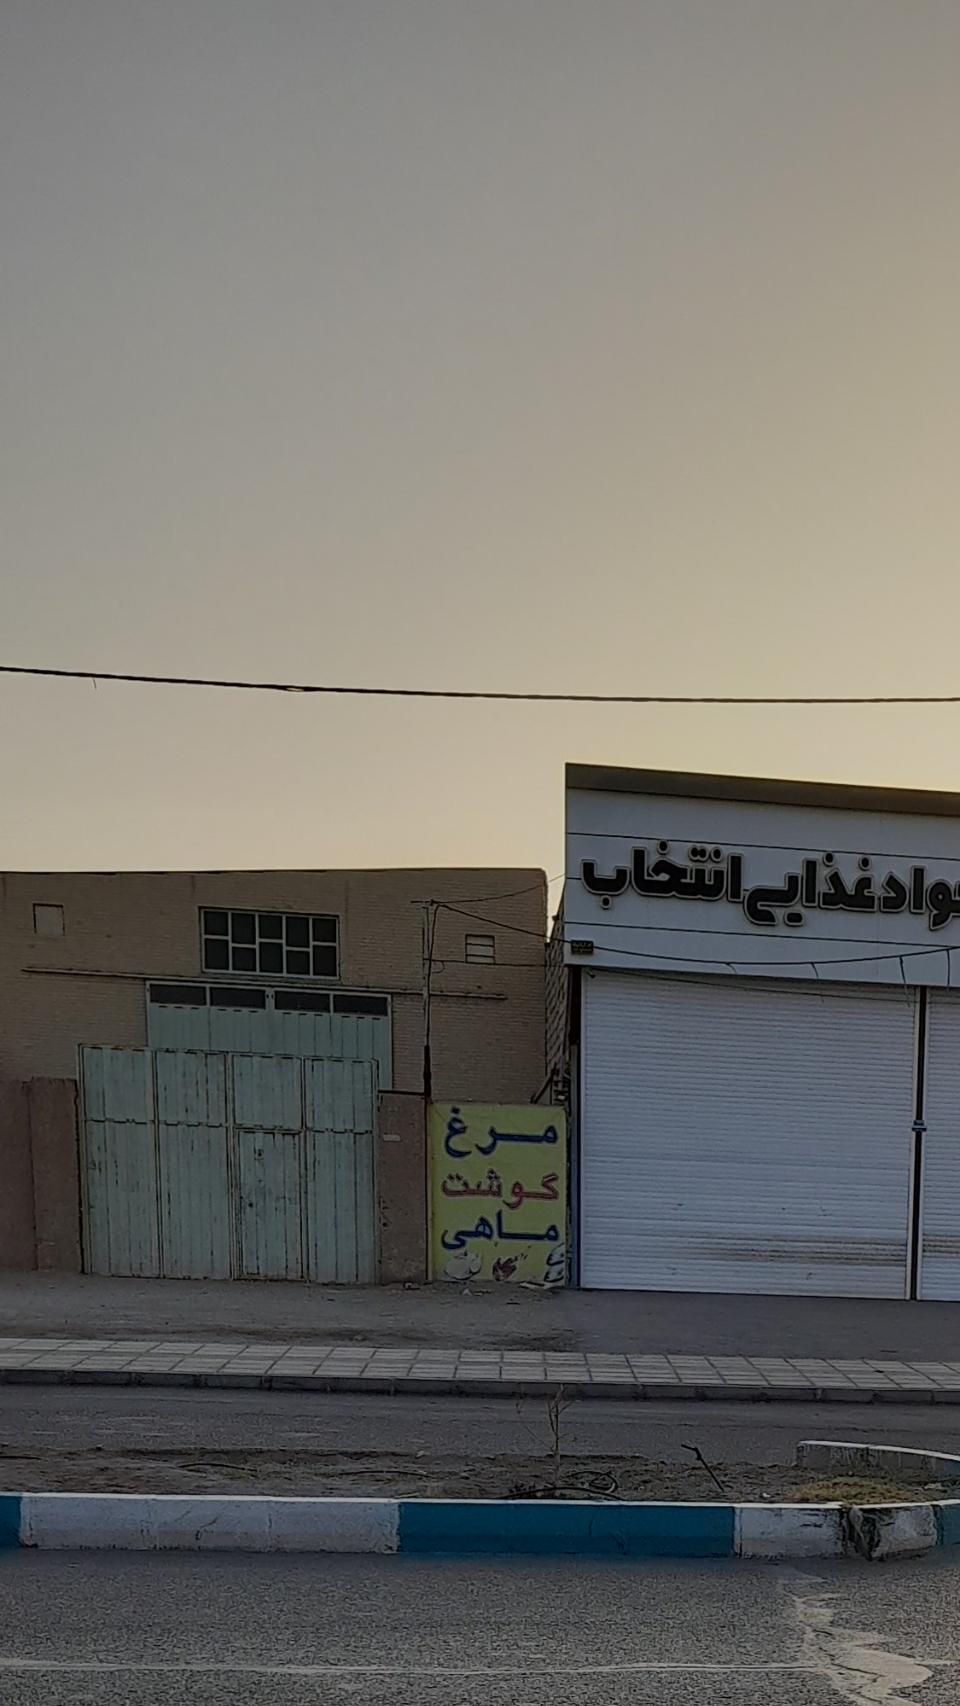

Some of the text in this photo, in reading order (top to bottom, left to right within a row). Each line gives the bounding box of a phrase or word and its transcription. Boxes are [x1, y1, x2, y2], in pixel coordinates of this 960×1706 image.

[580, 840, 745, 910] انتخاب
[743, 851, 876, 926] غذایی
[445, 1107, 558, 1157] مرغ
[442, 1169, 559, 1209] گوشت
[442, 1210, 559, 1250] ماهی
